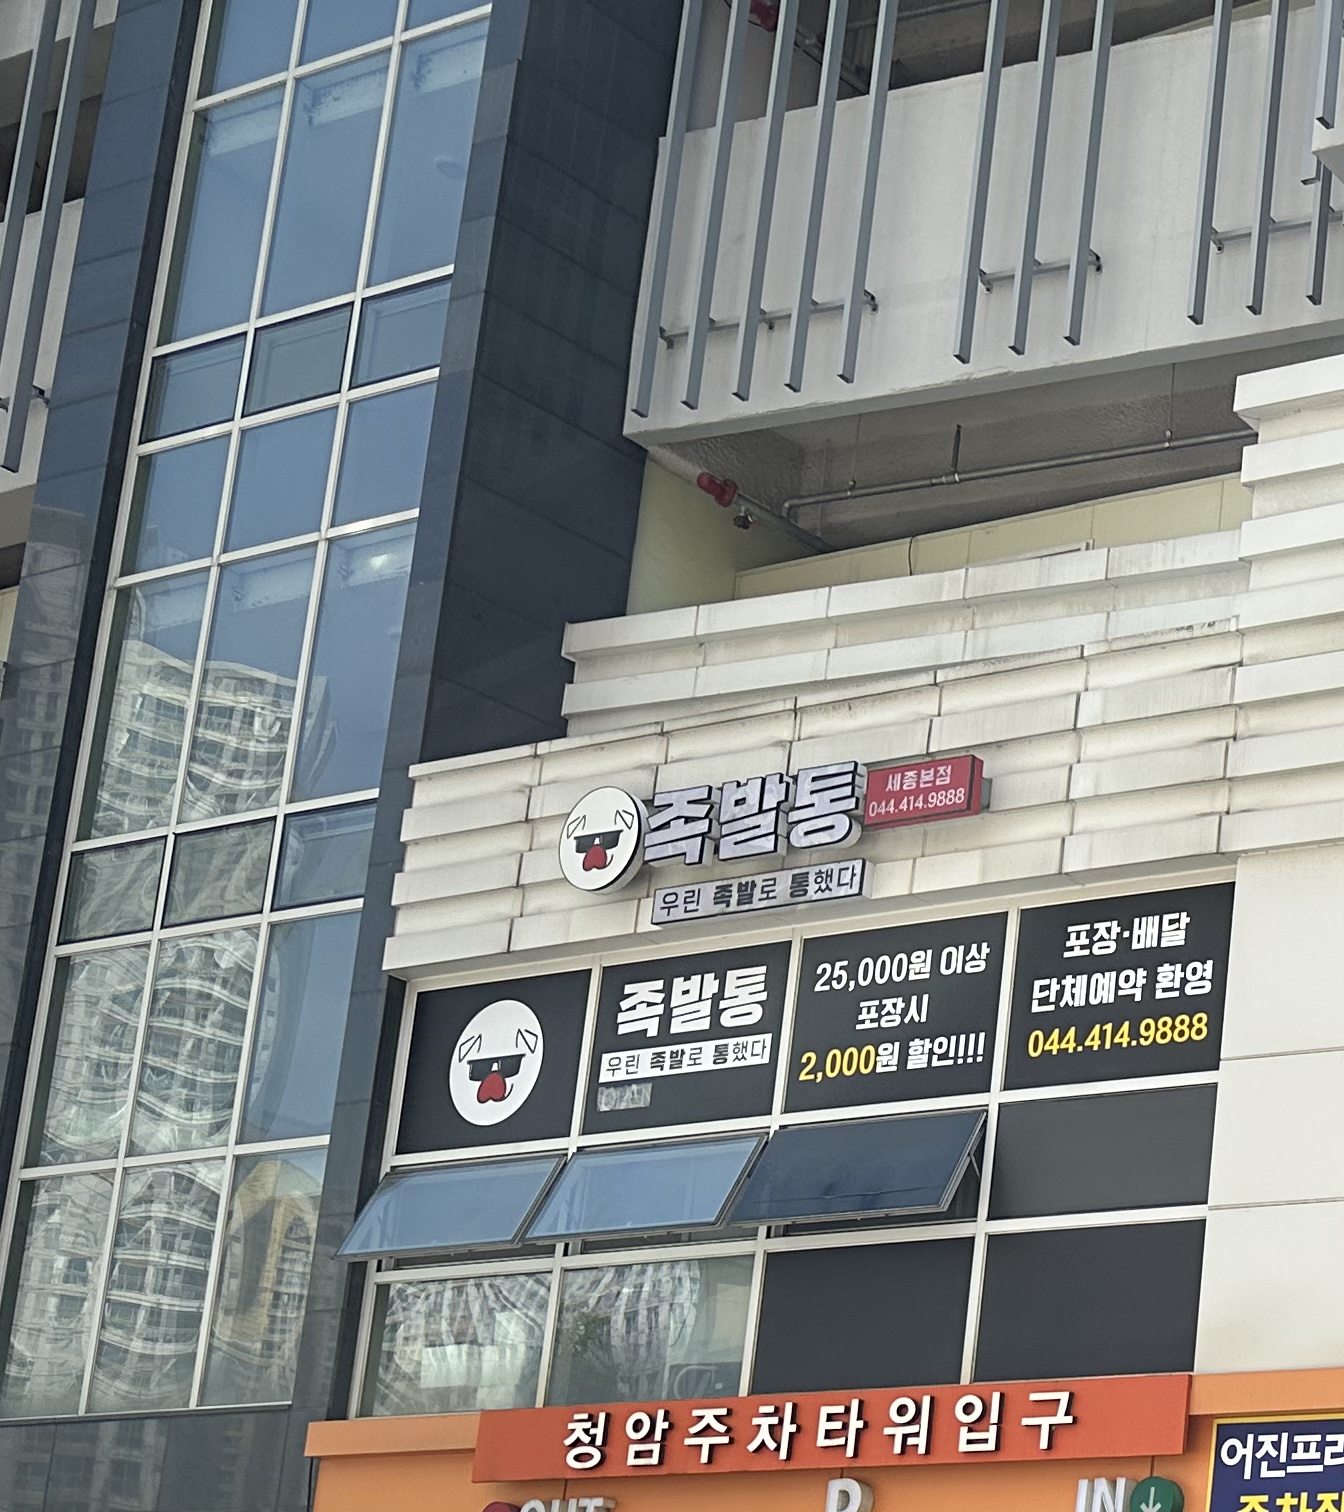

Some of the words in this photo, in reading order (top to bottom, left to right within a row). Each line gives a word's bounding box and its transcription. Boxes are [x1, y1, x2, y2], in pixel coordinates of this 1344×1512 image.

[868, 788, 966, 818] 044.414.9888
[885, 764, 952, 792] 세종본점
[644, 761, 864, 866] 족발통
[659, 887, 701, 916] 우린
[712, 877, 778, 909] 족발로
[788, 866, 858, 898] 통했다
[1063, 911, 1191, 959] 포장·배달
[814, 949, 931, 993] 25,000원
[939, 942, 991, 974] 이상
[1030, 969, 1147, 1014] 단체예약
[1154, 960, 1215, 1000] 환영
[617, 965, 768, 1038] 족발통
[855, 994, 929, 1031] 포장시
[605, 1053, 641, 1077] 우린
[649, 1047, 703, 1072] 족발로
[712, 1038, 767, 1066] 통했다
[798, 1041, 899, 1083] 2,000원
[906, 1032, 986, 1070] 할인!!!
[1028, 1012, 1209, 1058] 044.414.9888
[563, 1391, 1076, 1470] 청암주차타워입구
